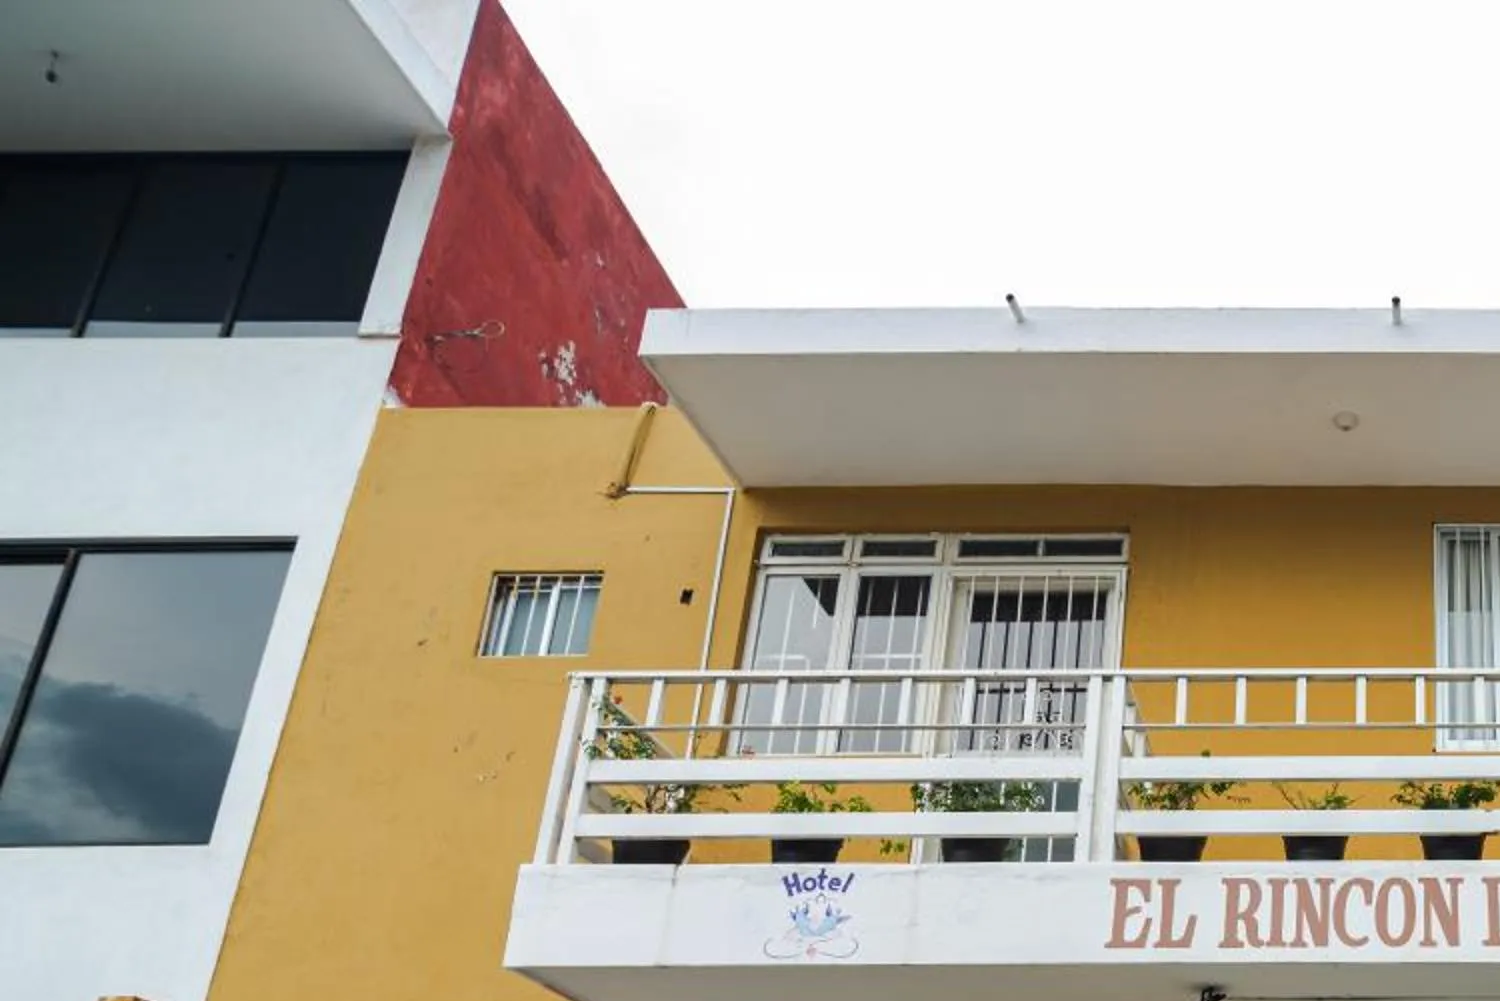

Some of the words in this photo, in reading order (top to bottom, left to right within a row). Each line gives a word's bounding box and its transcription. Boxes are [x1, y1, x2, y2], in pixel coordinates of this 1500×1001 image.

[781, 867, 855, 897] Hotel
[1104, 877, 1198, 949] EL
[1218, 875, 1464, 949] RINCON
